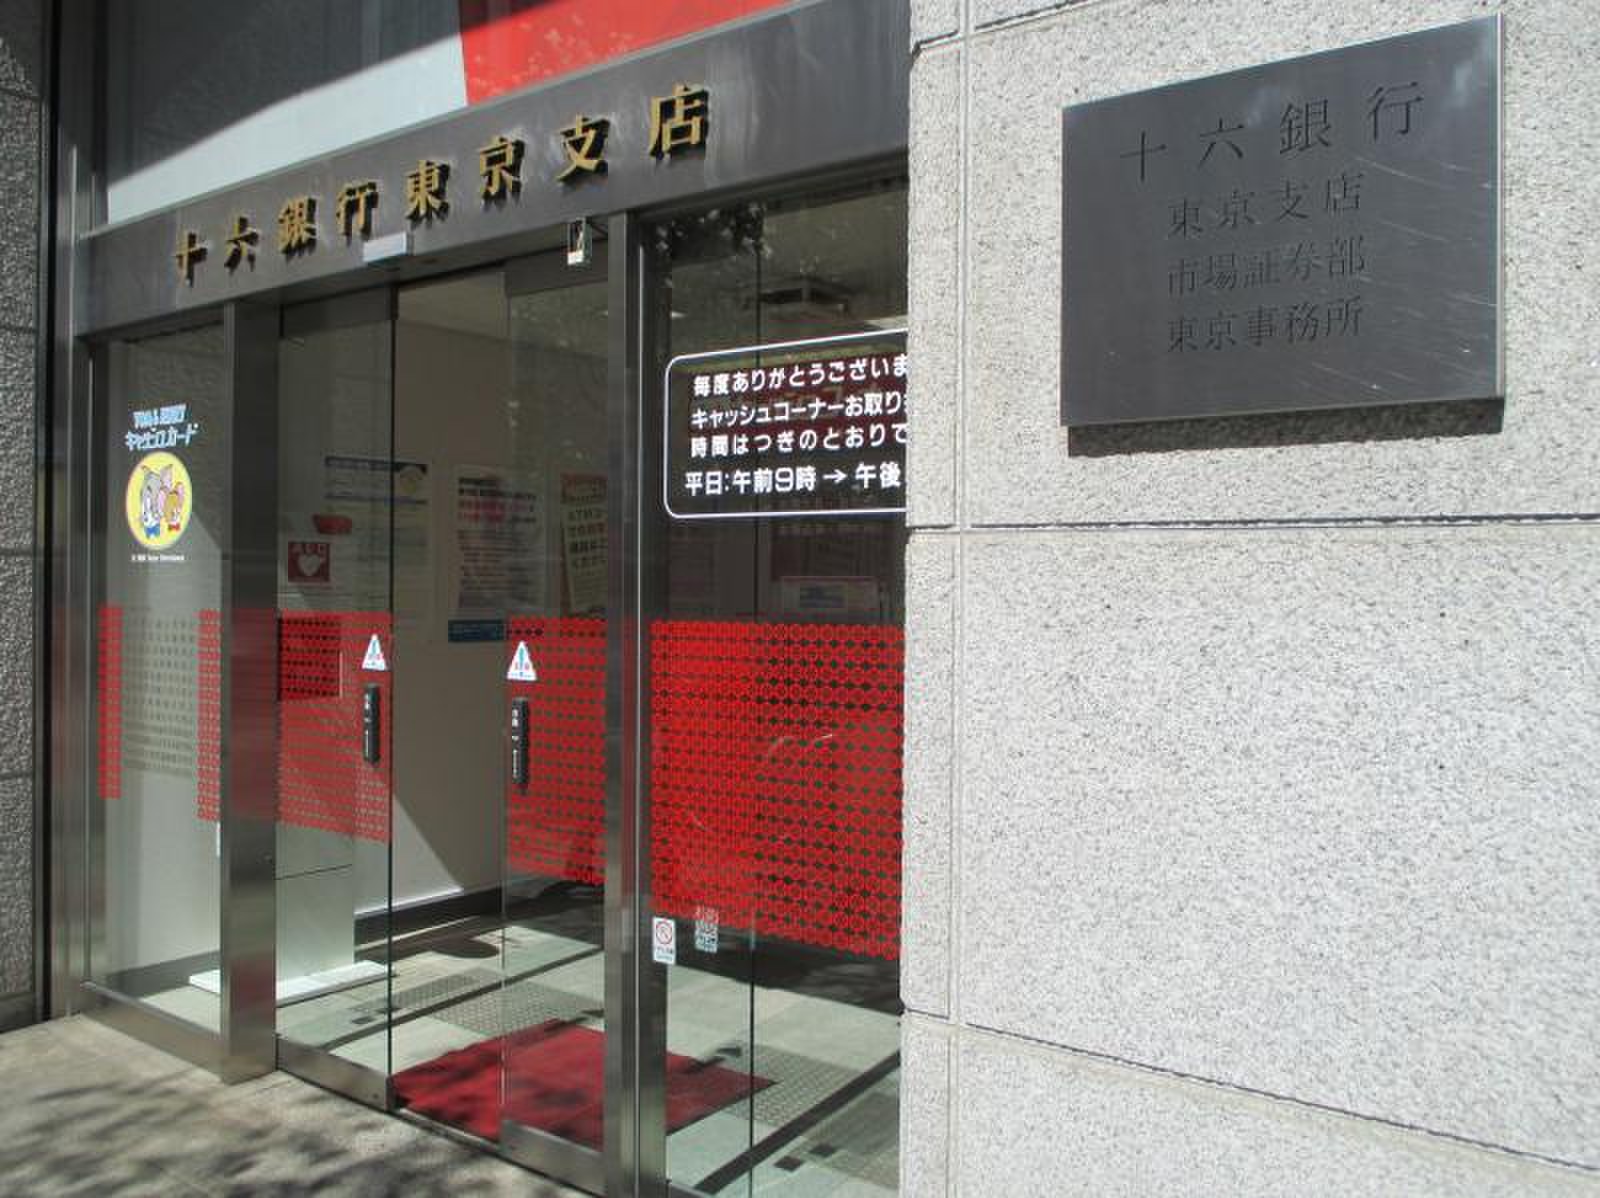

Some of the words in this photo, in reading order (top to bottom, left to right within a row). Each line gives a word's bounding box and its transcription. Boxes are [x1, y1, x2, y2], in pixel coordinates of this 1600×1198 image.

[1119, 81, 1423, 183] 十六銀行
[174, 84, 710, 286] 十六銀行東京支店
[1168, 173, 1365, 239] 東京支店
[1167, 295, 1365, 354] 東京事務所
[691, 391, 908, 430] キャッシュコーナーお取り
[855, 462, 902, 489] 午後
